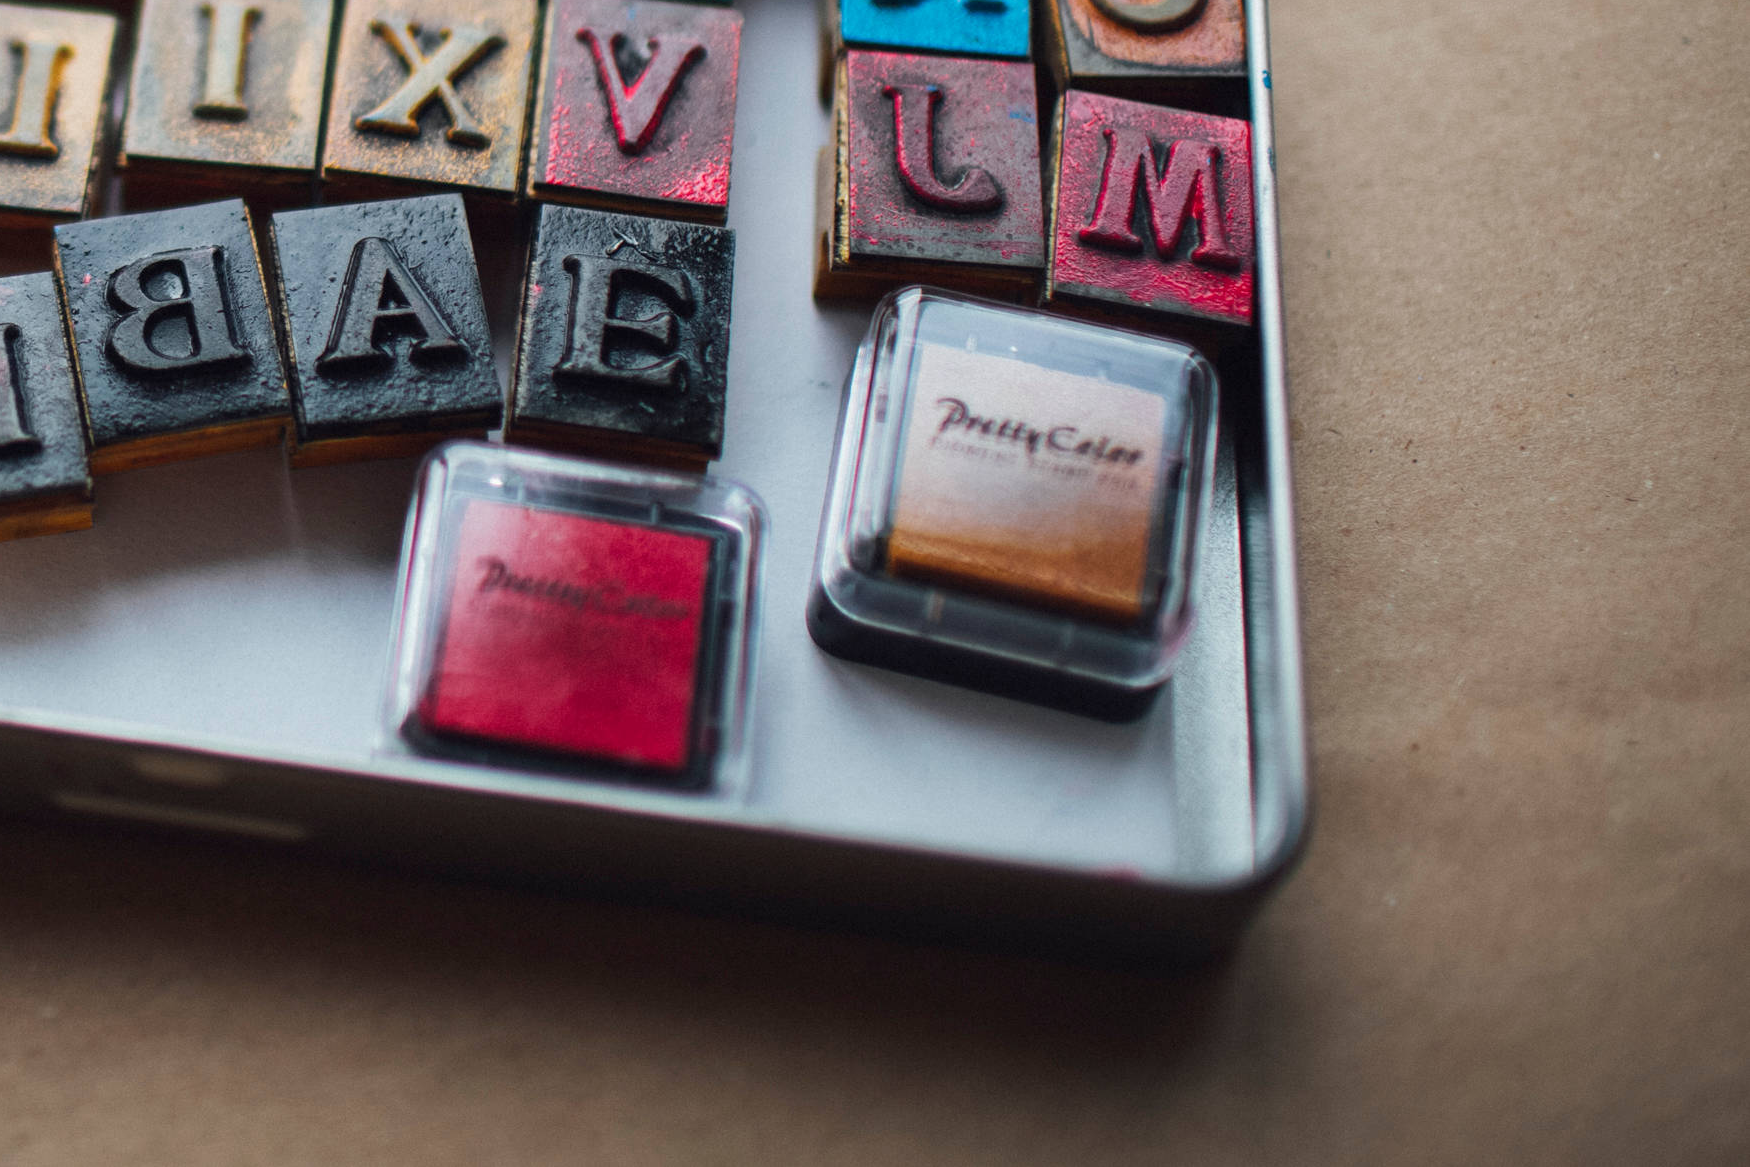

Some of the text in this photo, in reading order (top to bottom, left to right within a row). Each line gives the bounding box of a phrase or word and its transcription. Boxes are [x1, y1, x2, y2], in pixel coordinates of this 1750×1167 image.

[192, 4, 262, 122] I
[353, 17, 508, 148] X
[576, 28, 707, 156] V
[1077, 129, 1240, 271] M
[315, 237, 470, 377] A
[552, 252, 698, 396] E
